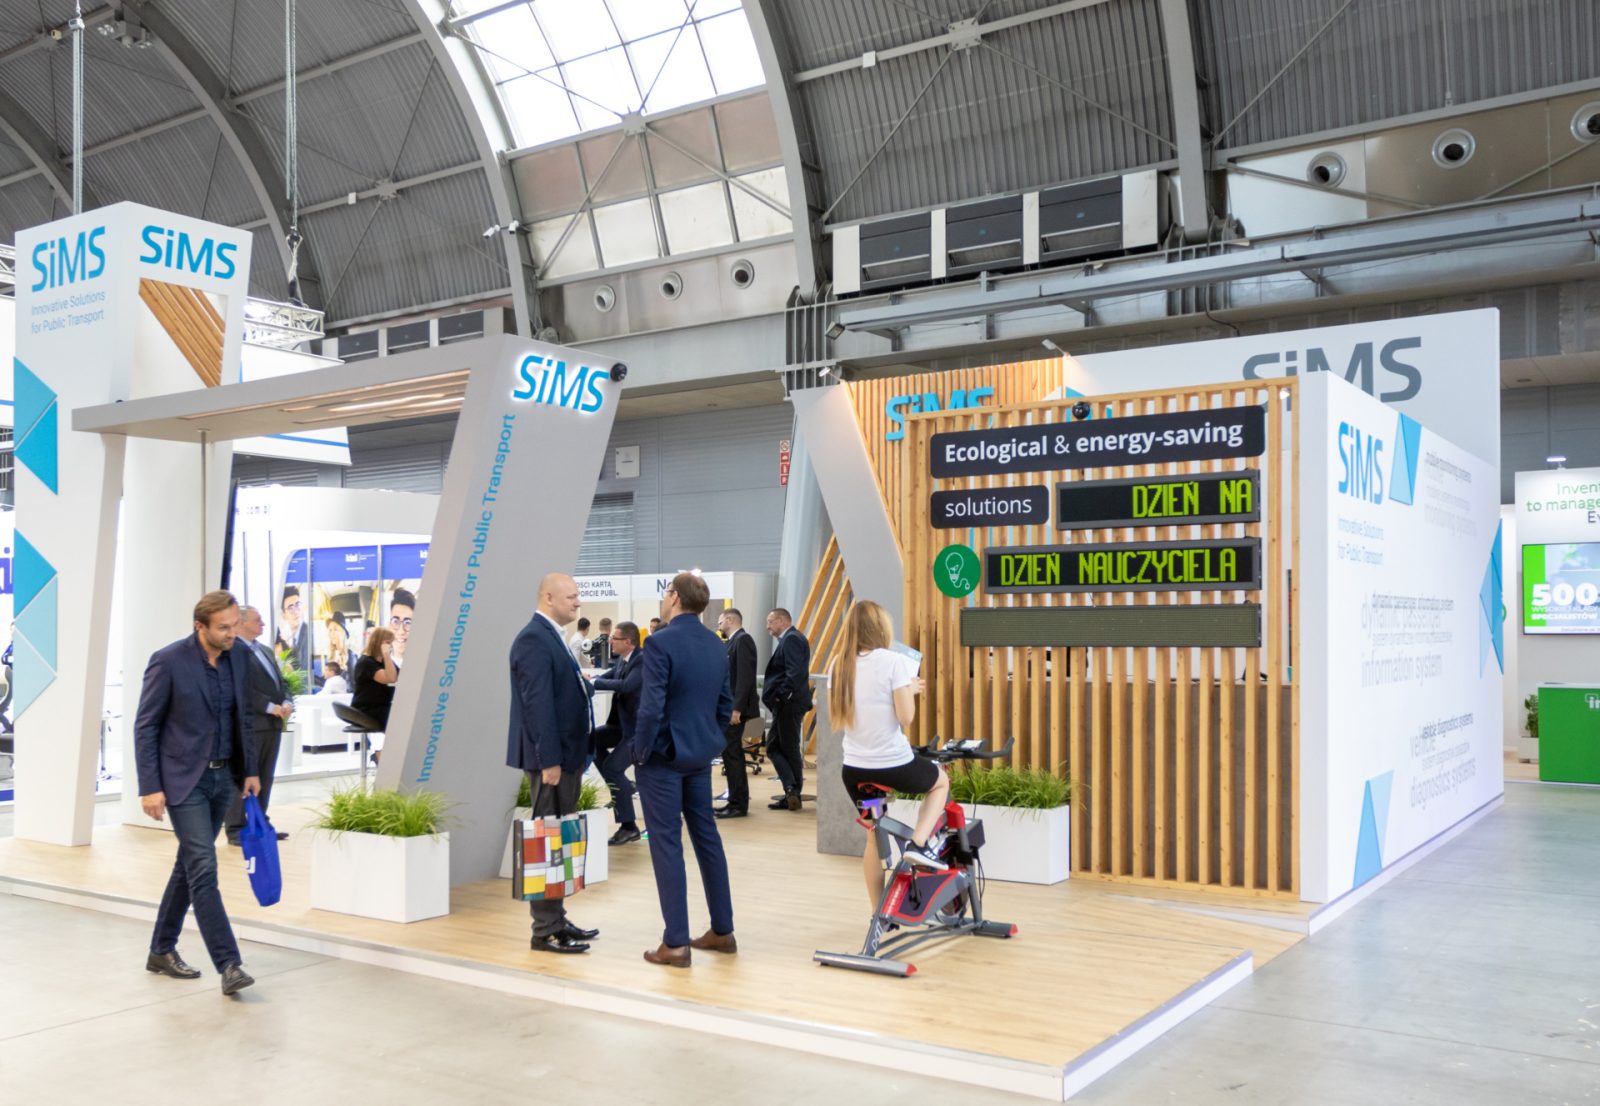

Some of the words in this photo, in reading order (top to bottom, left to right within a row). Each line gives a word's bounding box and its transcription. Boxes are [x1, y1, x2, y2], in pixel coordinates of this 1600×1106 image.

[31, 226, 106, 292] SiMS
[140, 225, 237, 280] SiMS
[31, 299, 69, 316] Innovative
[70, 291, 105, 308] Solutions
[31, 322, 42, 335] for
[43, 316, 66, 332] Public
[68, 309, 104, 326] Transport
[513, 355, 610, 413] SiMS
[482, 414, 516, 506] Transport
[945, 435, 1047, 464] Ecological
[1054, 435, 1070, 454] &
[1075, 422, 1243, 454] energy-saving
[1338, 421, 1383, 505] SiMS
[945, 496, 1032, 517] solutions
[1132, 481, 1199, 518] DZIEŃ
[1219, 479, 1252, 513] NA
[1526, 500, 1542, 512] to
[1557, 482, 1600, 495] Inven
[467, 510, 493, 568] Public
[460, 573, 478, 599] for
[1001, 552, 1060, 585] DZIEŃ
[1079, 548, 1237, 584] NAUCZYCIELA
[1531, 582, 1598, 606] 500
[439, 603, 472, 688] Solutions
[416, 692, 449, 783] Innovative
